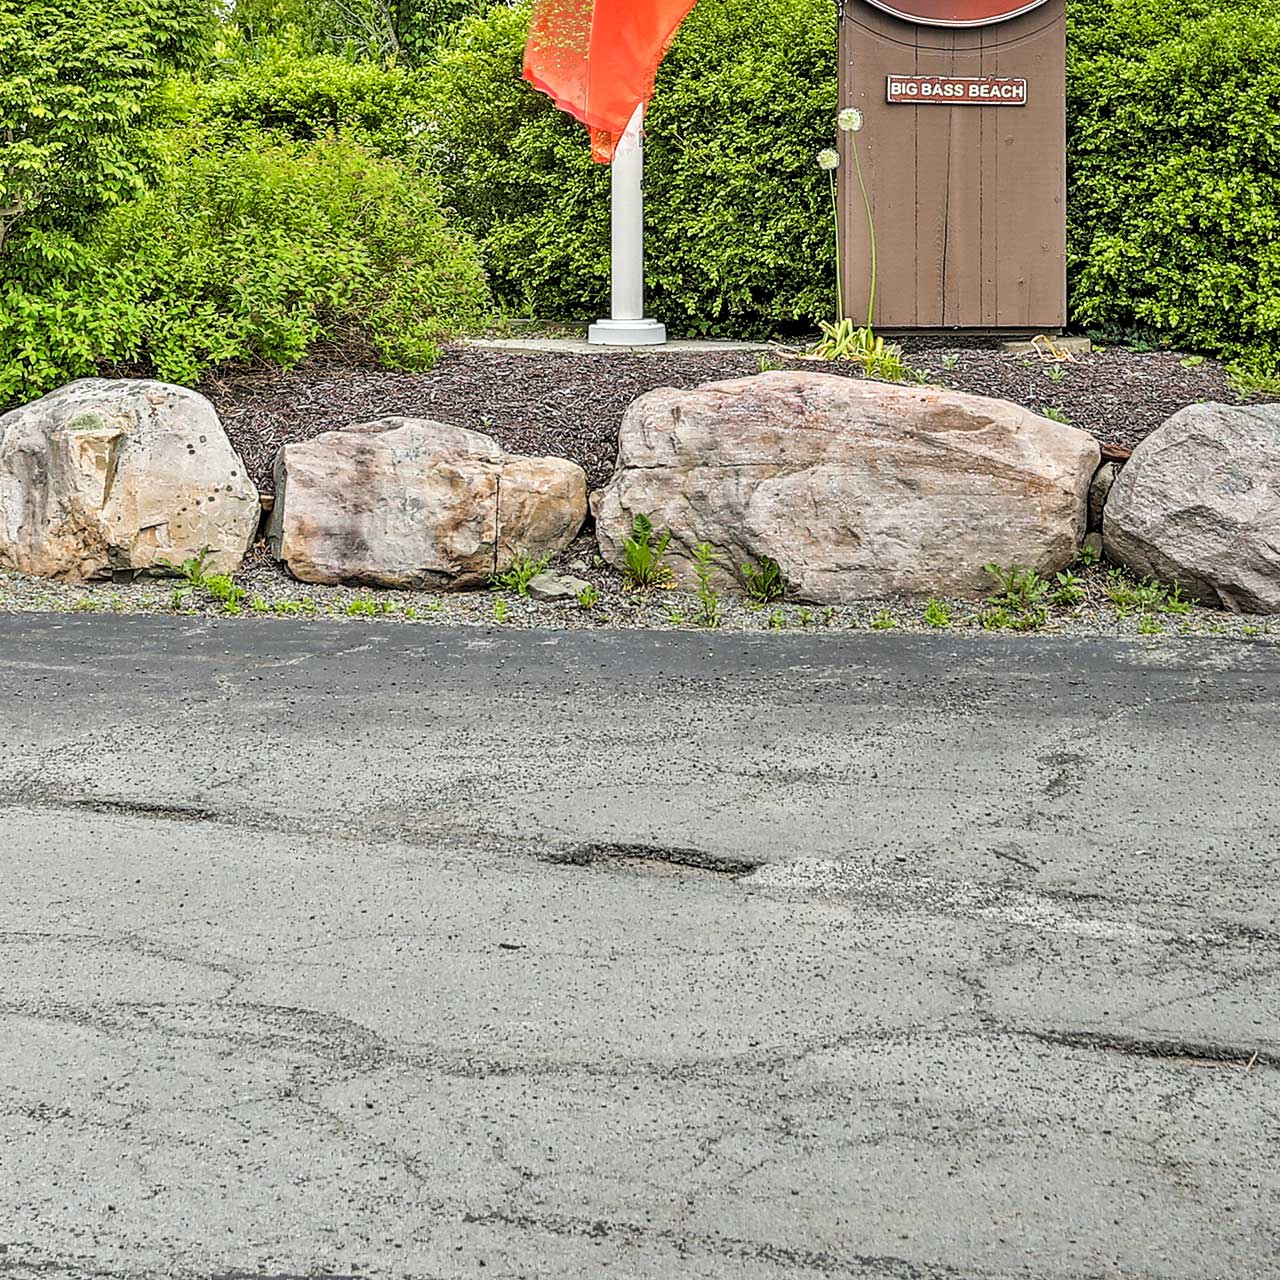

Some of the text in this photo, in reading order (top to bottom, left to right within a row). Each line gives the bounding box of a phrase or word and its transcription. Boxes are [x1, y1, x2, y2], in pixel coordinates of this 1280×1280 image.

[891, 82, 1024, 98] BIG BASS BEACH
